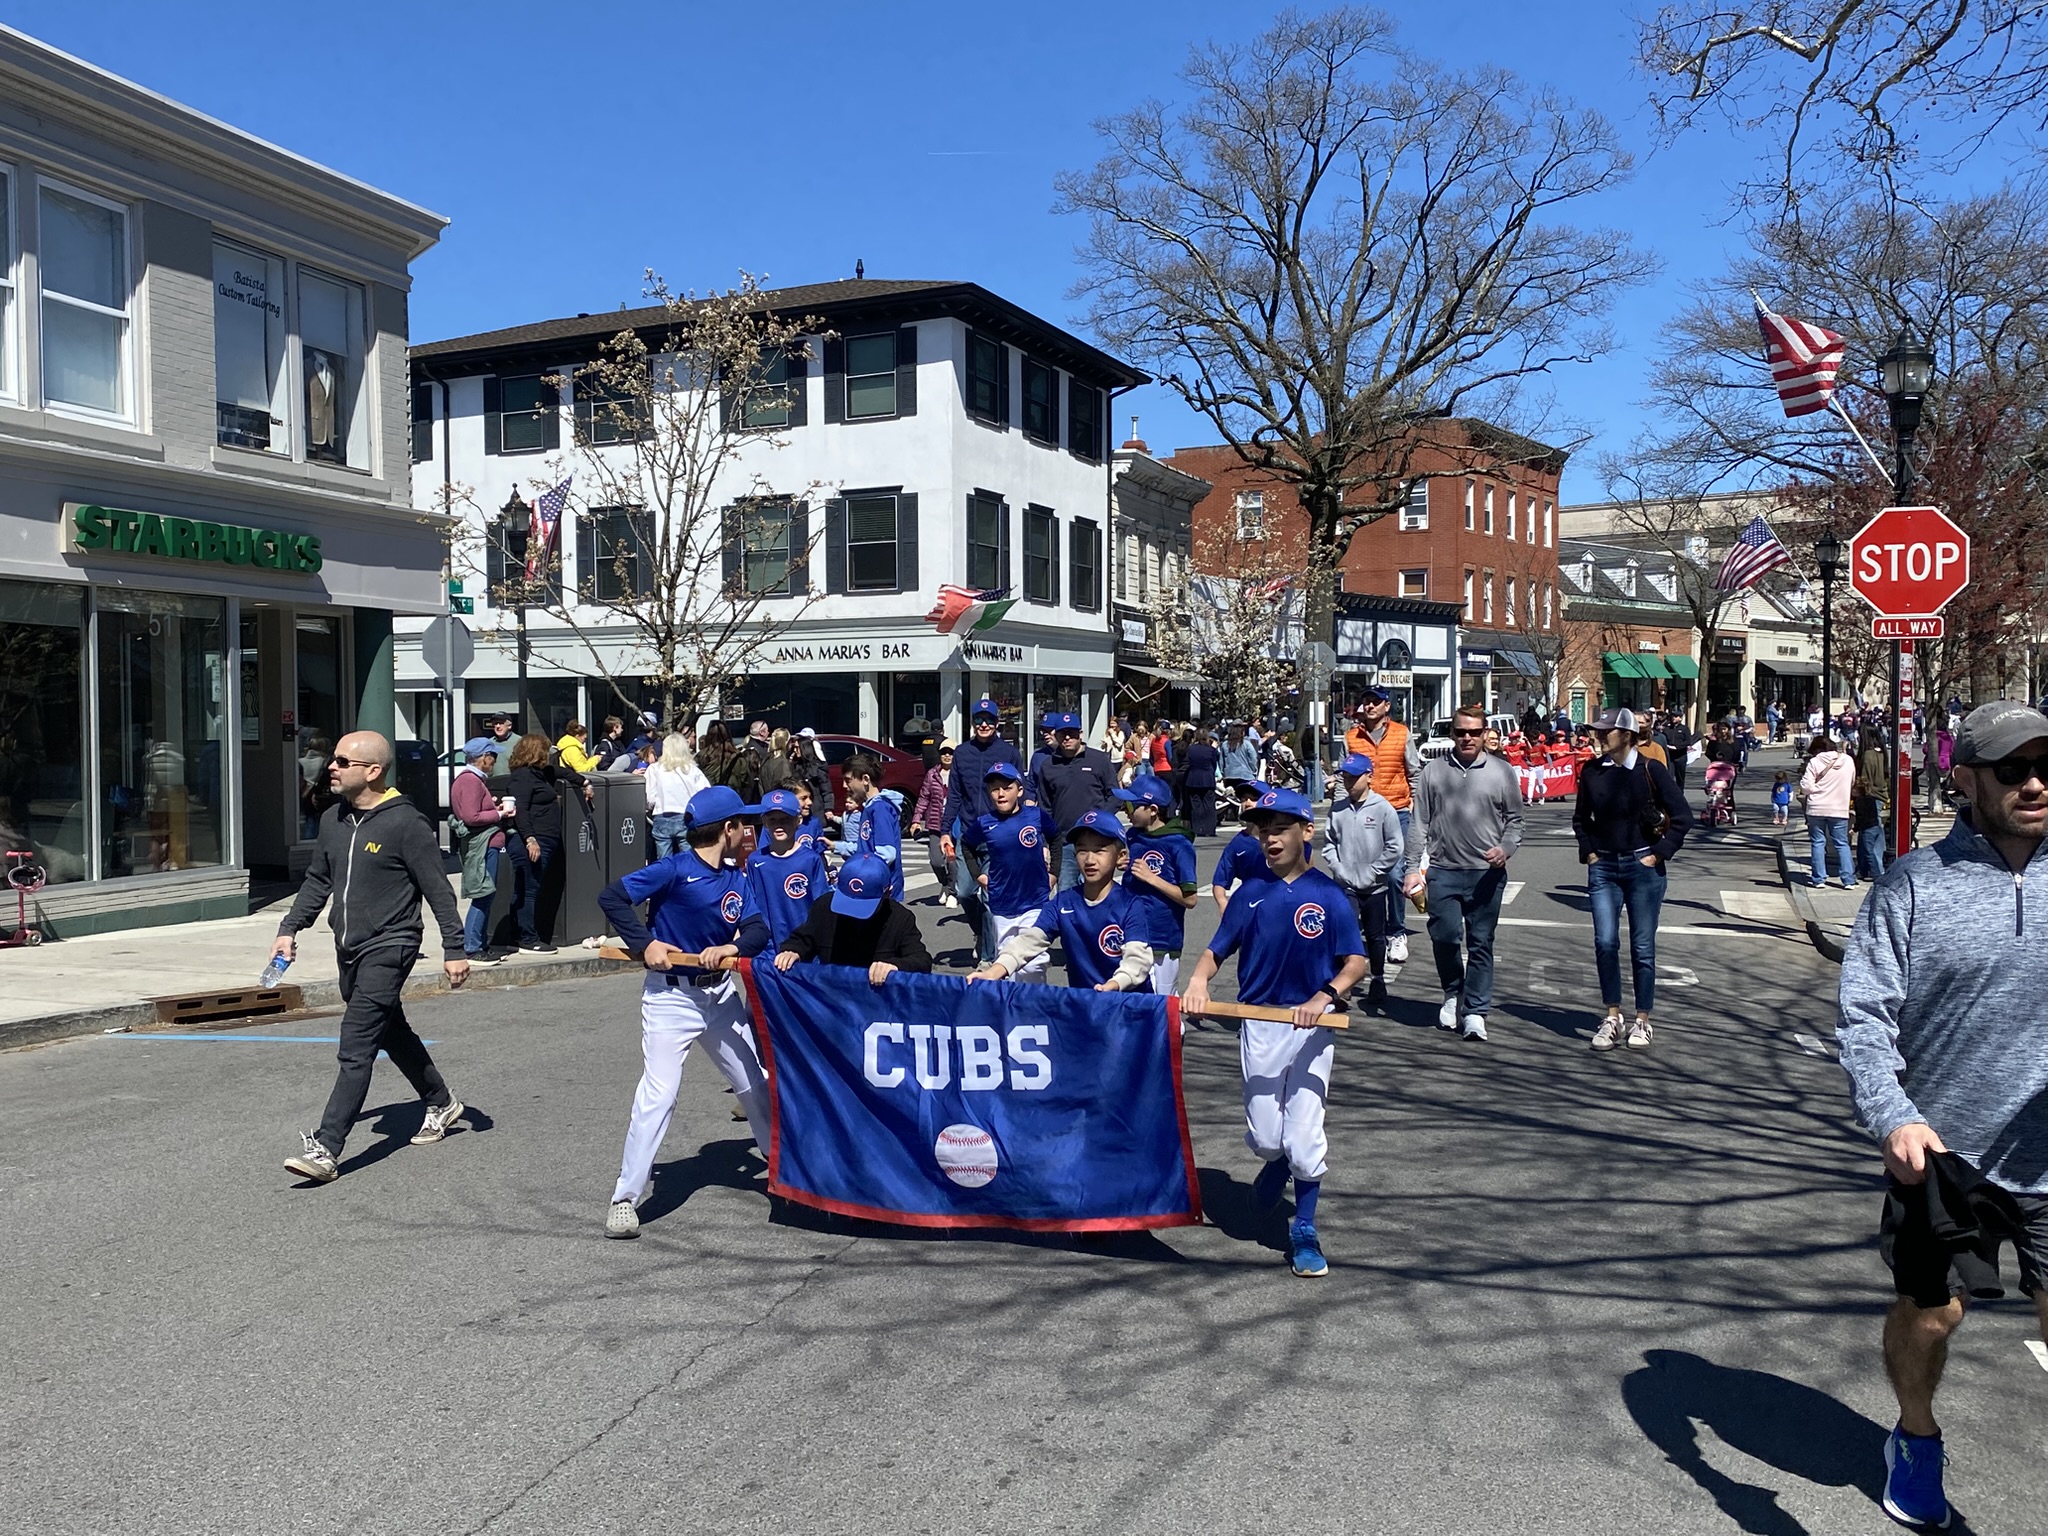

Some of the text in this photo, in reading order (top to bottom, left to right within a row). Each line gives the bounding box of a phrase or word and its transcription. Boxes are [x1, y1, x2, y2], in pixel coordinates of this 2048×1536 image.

[233, 270, 265, 292] Batista
[218, 283, 281, 318] Custom Tailoring
[75, 505, 323, 574] STARBUCKS
[1858, 542, 1960, 583] STOP
[149, 612, 172, 637] 51
[1879, 621, 1937, 635] ALL WAY
[776, 643, 910, 661] ANNA MARIA'S BAR
[860, 711, 867, 719] 53
[864, 1021, 1053, 1092] CUBS
